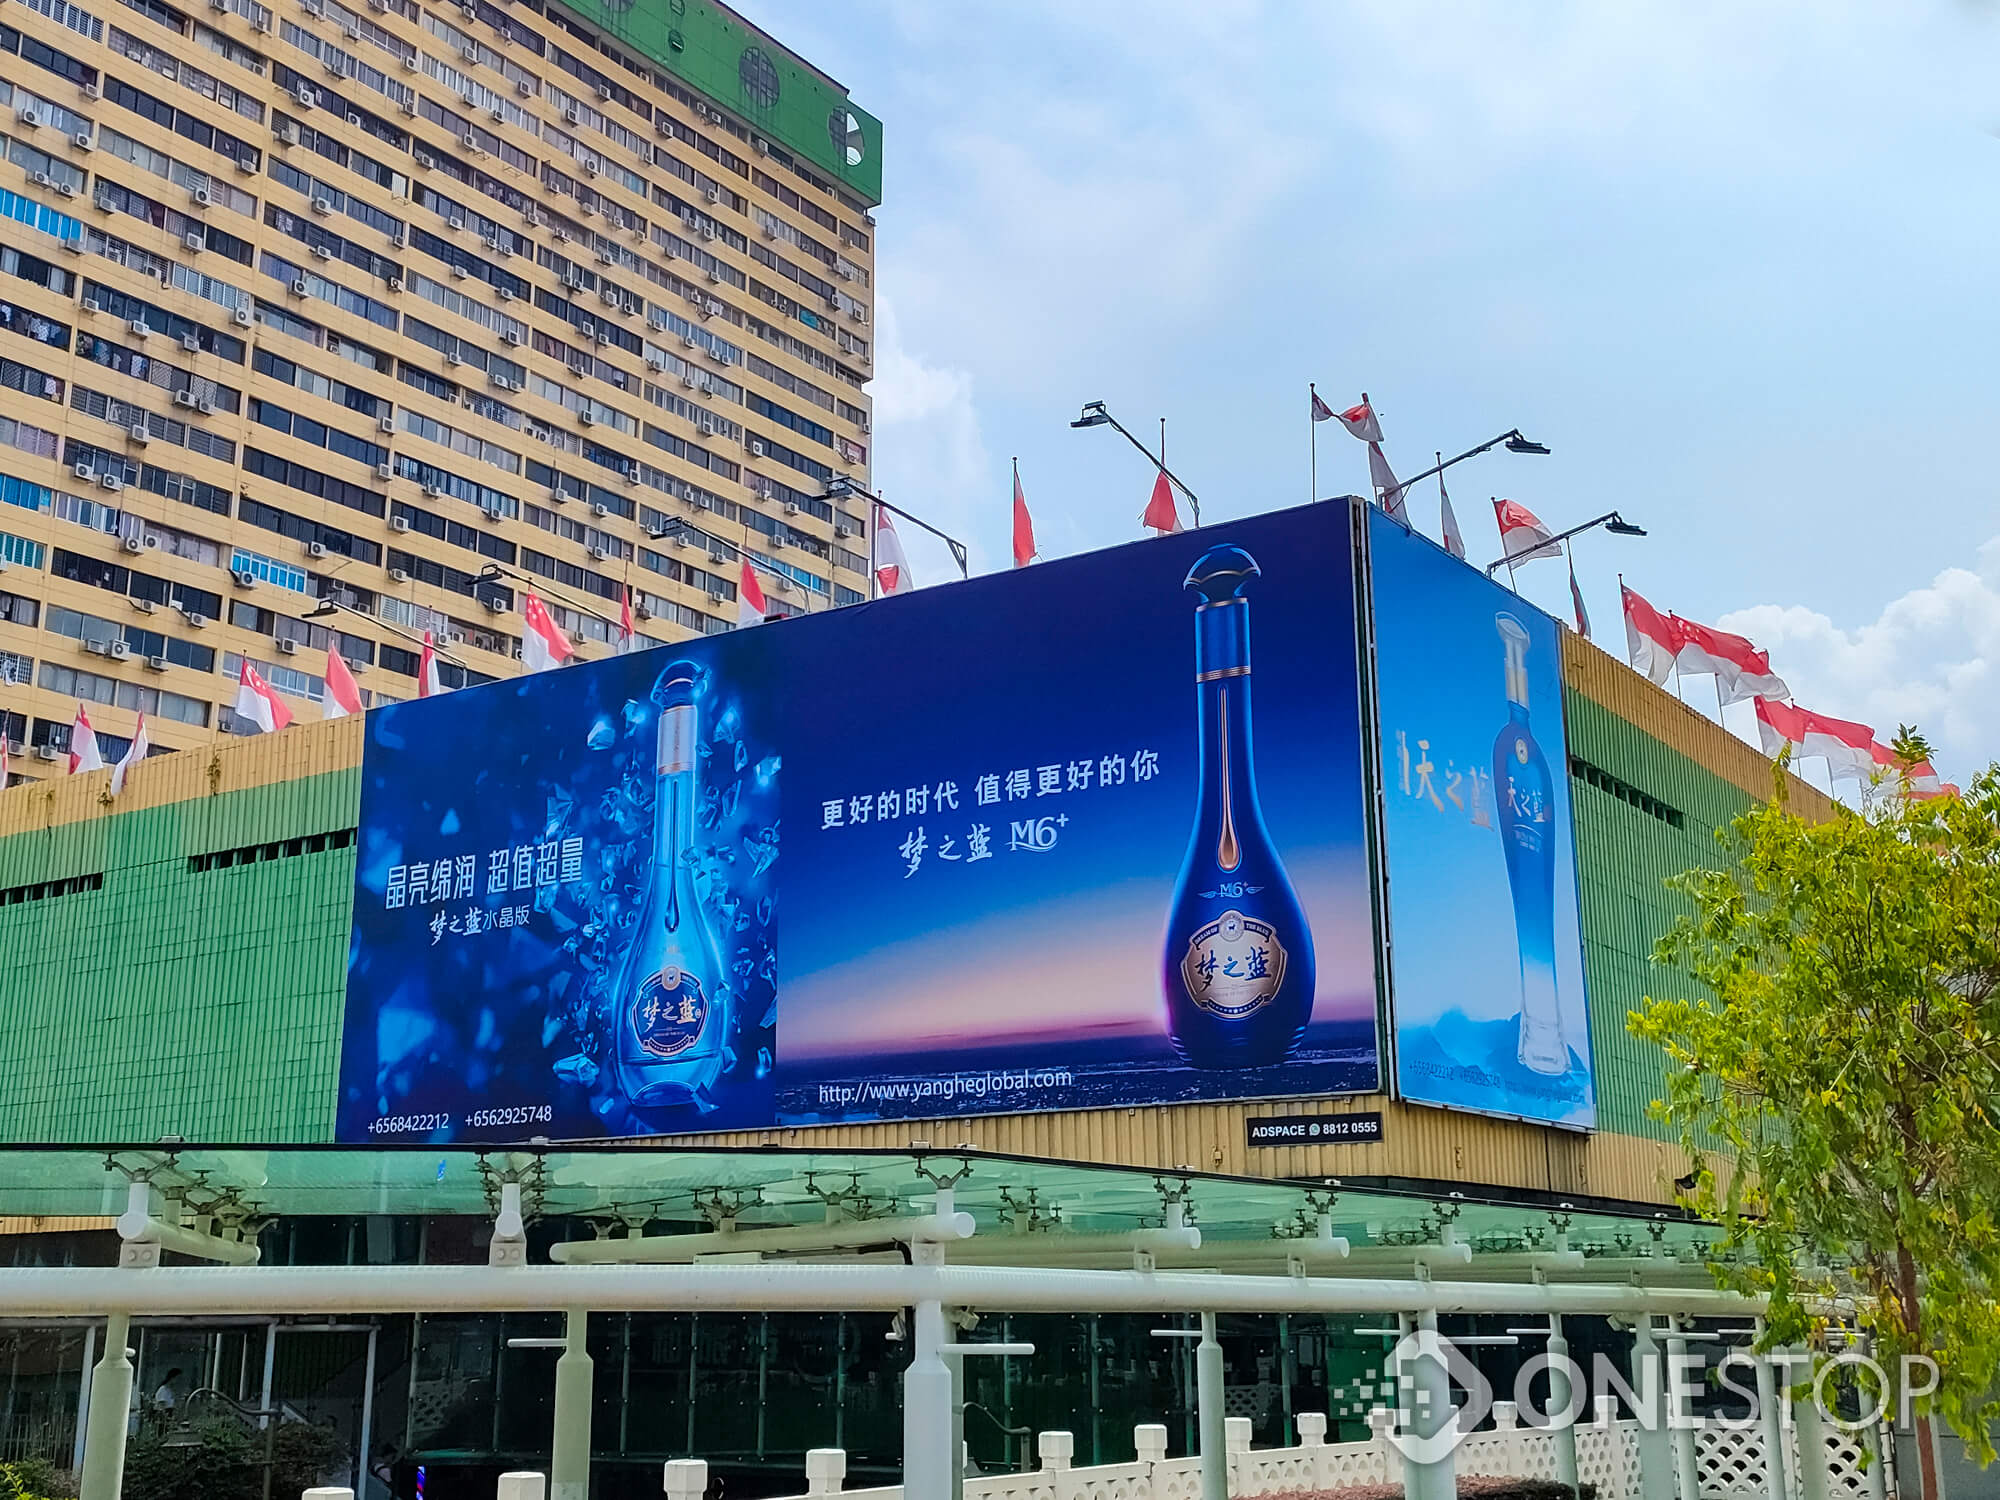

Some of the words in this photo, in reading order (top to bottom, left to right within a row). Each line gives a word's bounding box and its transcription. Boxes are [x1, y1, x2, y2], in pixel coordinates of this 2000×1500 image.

[821, 781, 959, 830] 更好的时代
[974, 749, 1160, 806] 值得更好的你
[899, 823, 993, 879] 梦之蓝
[385, 854, 476, 910] 晶亮绵润
[486, 837, 584, 895] 超值超量
[429, 904, 531, 946] 梦之蓝水晶版
[1195, 946, 1271, 992] 梦之蓝
[642, 994, 697, 1033] 梦之蓝
[819, 1069, 1072, 1106] http://www.yangheglobal.com
[368, 1113, 449, 1134] +6568422212
[465, 1105, 552, 1127] +6562925748
[1252, 1125, 1305, 1138] ADSPACE
[1323, 1123, 1349, 1135] 8812
[1351, 1121, 1377, 1133] 0555
